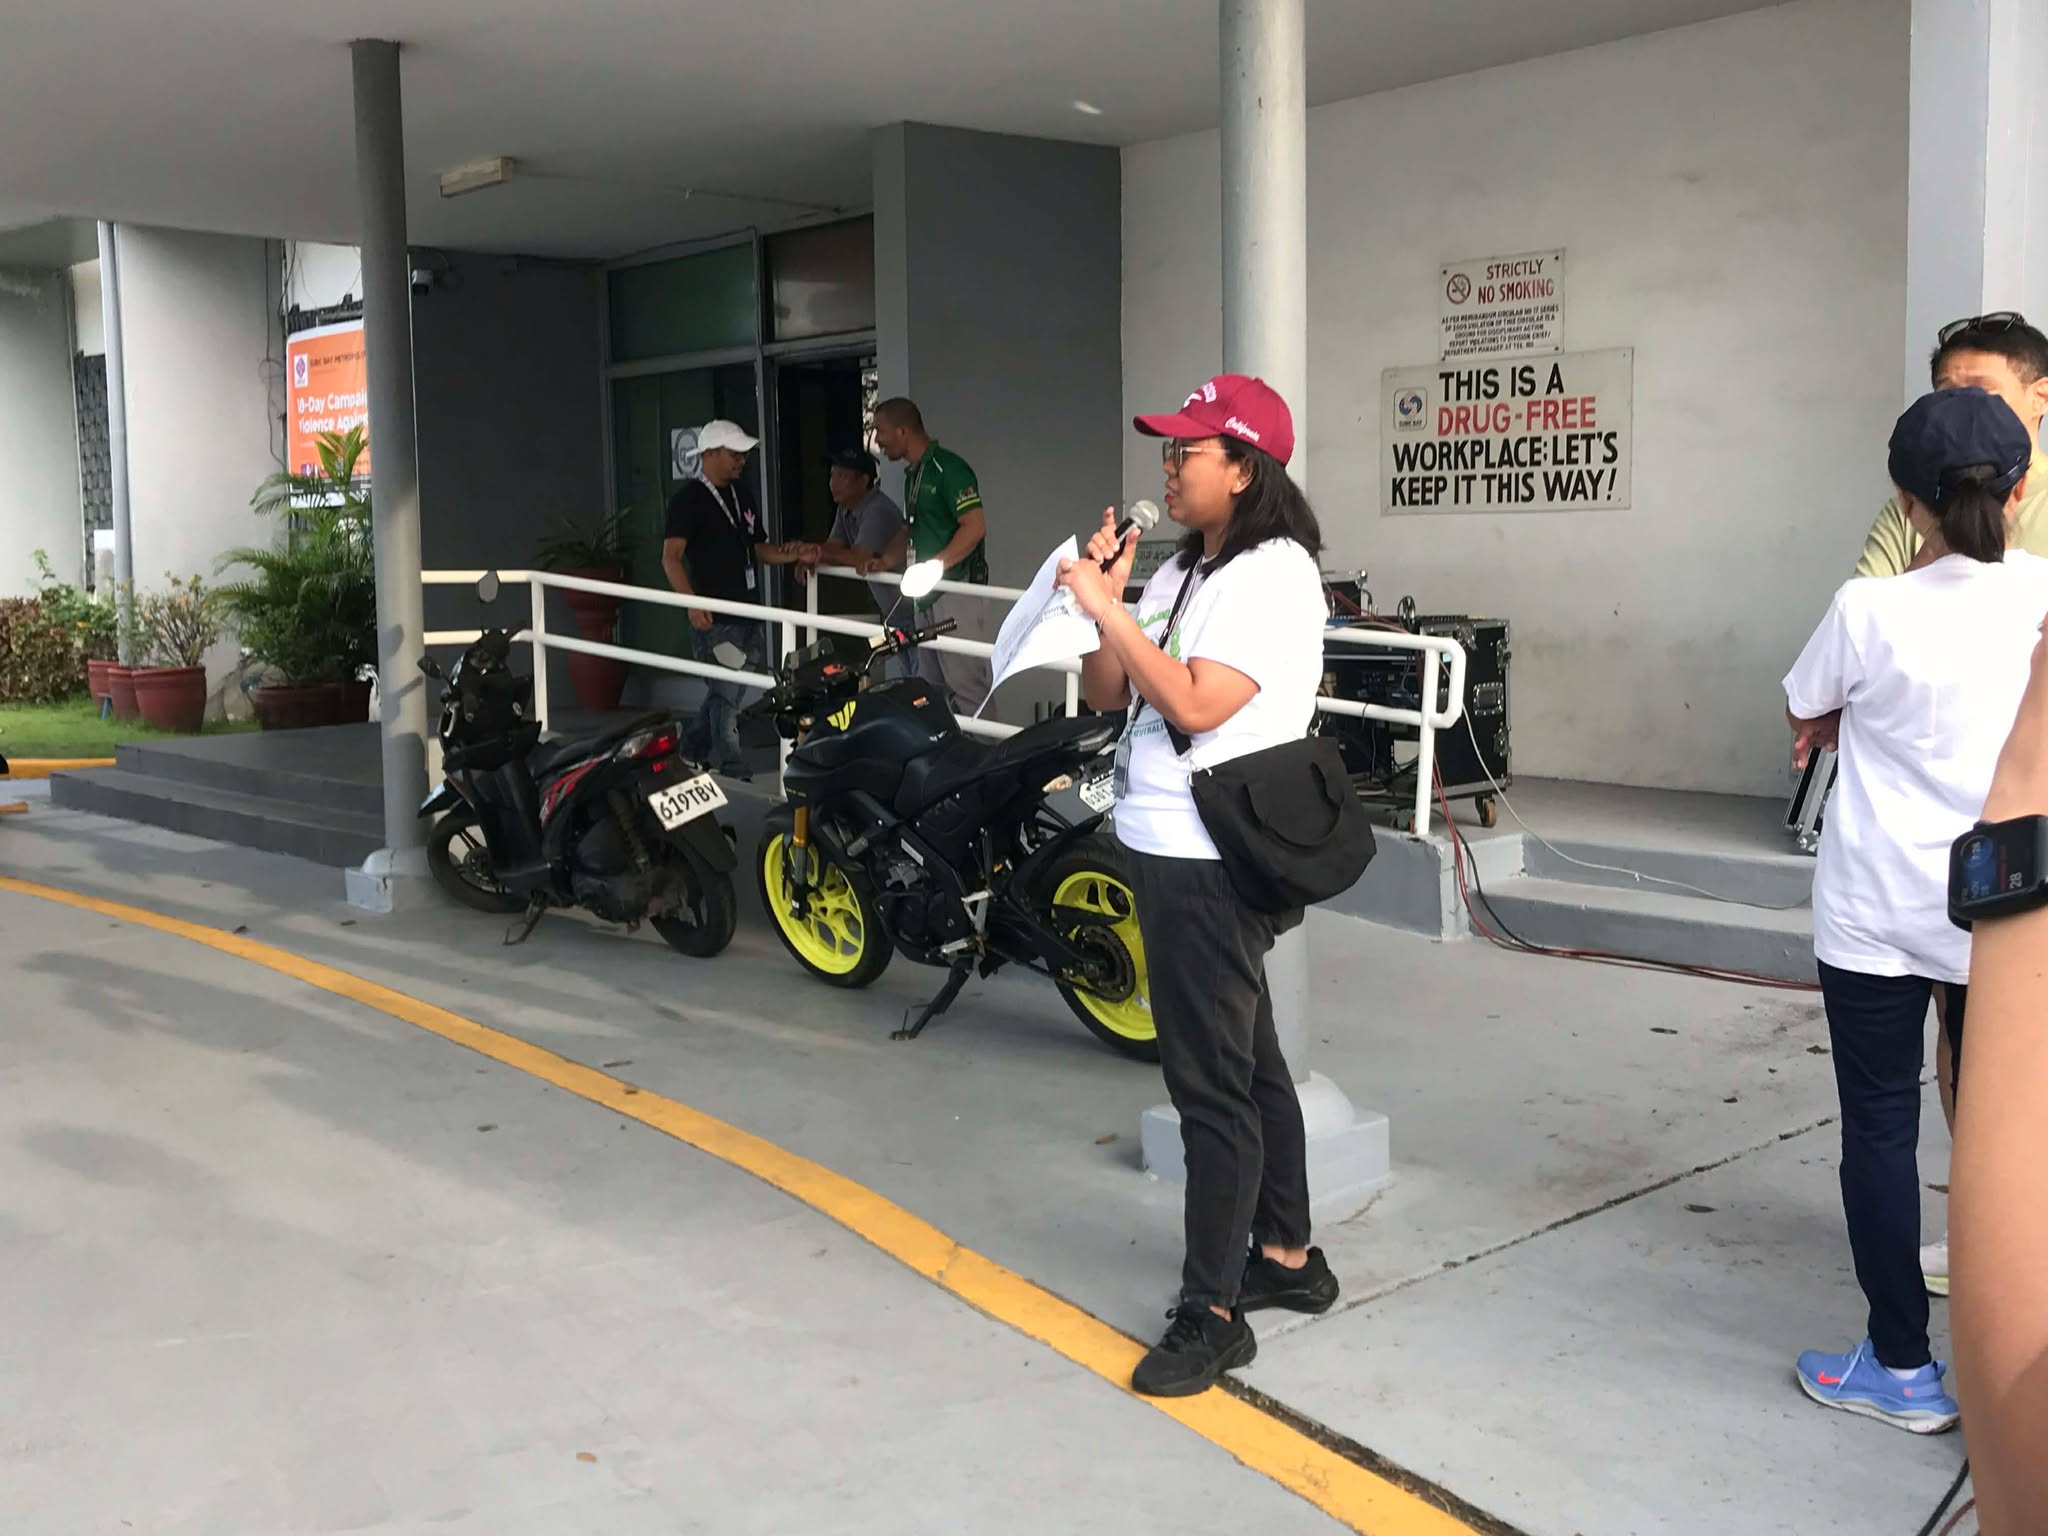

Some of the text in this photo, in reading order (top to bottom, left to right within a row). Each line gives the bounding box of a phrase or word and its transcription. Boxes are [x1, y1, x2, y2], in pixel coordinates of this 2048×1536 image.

[1487, 259, 1544, 280] STRICTLY
[1478, 279, 1554, 305] NO SMOKING
[1439, 363, 1564, 402] THIS IS A
[1437, 396, 1596, 436] DRUG-FREE
[1552, 432, 1618, 466] LET'S
[1391, 468, 1617, 507] KEEP IT THIS WAY!
[659, 781, 719, 821] 619TBY
